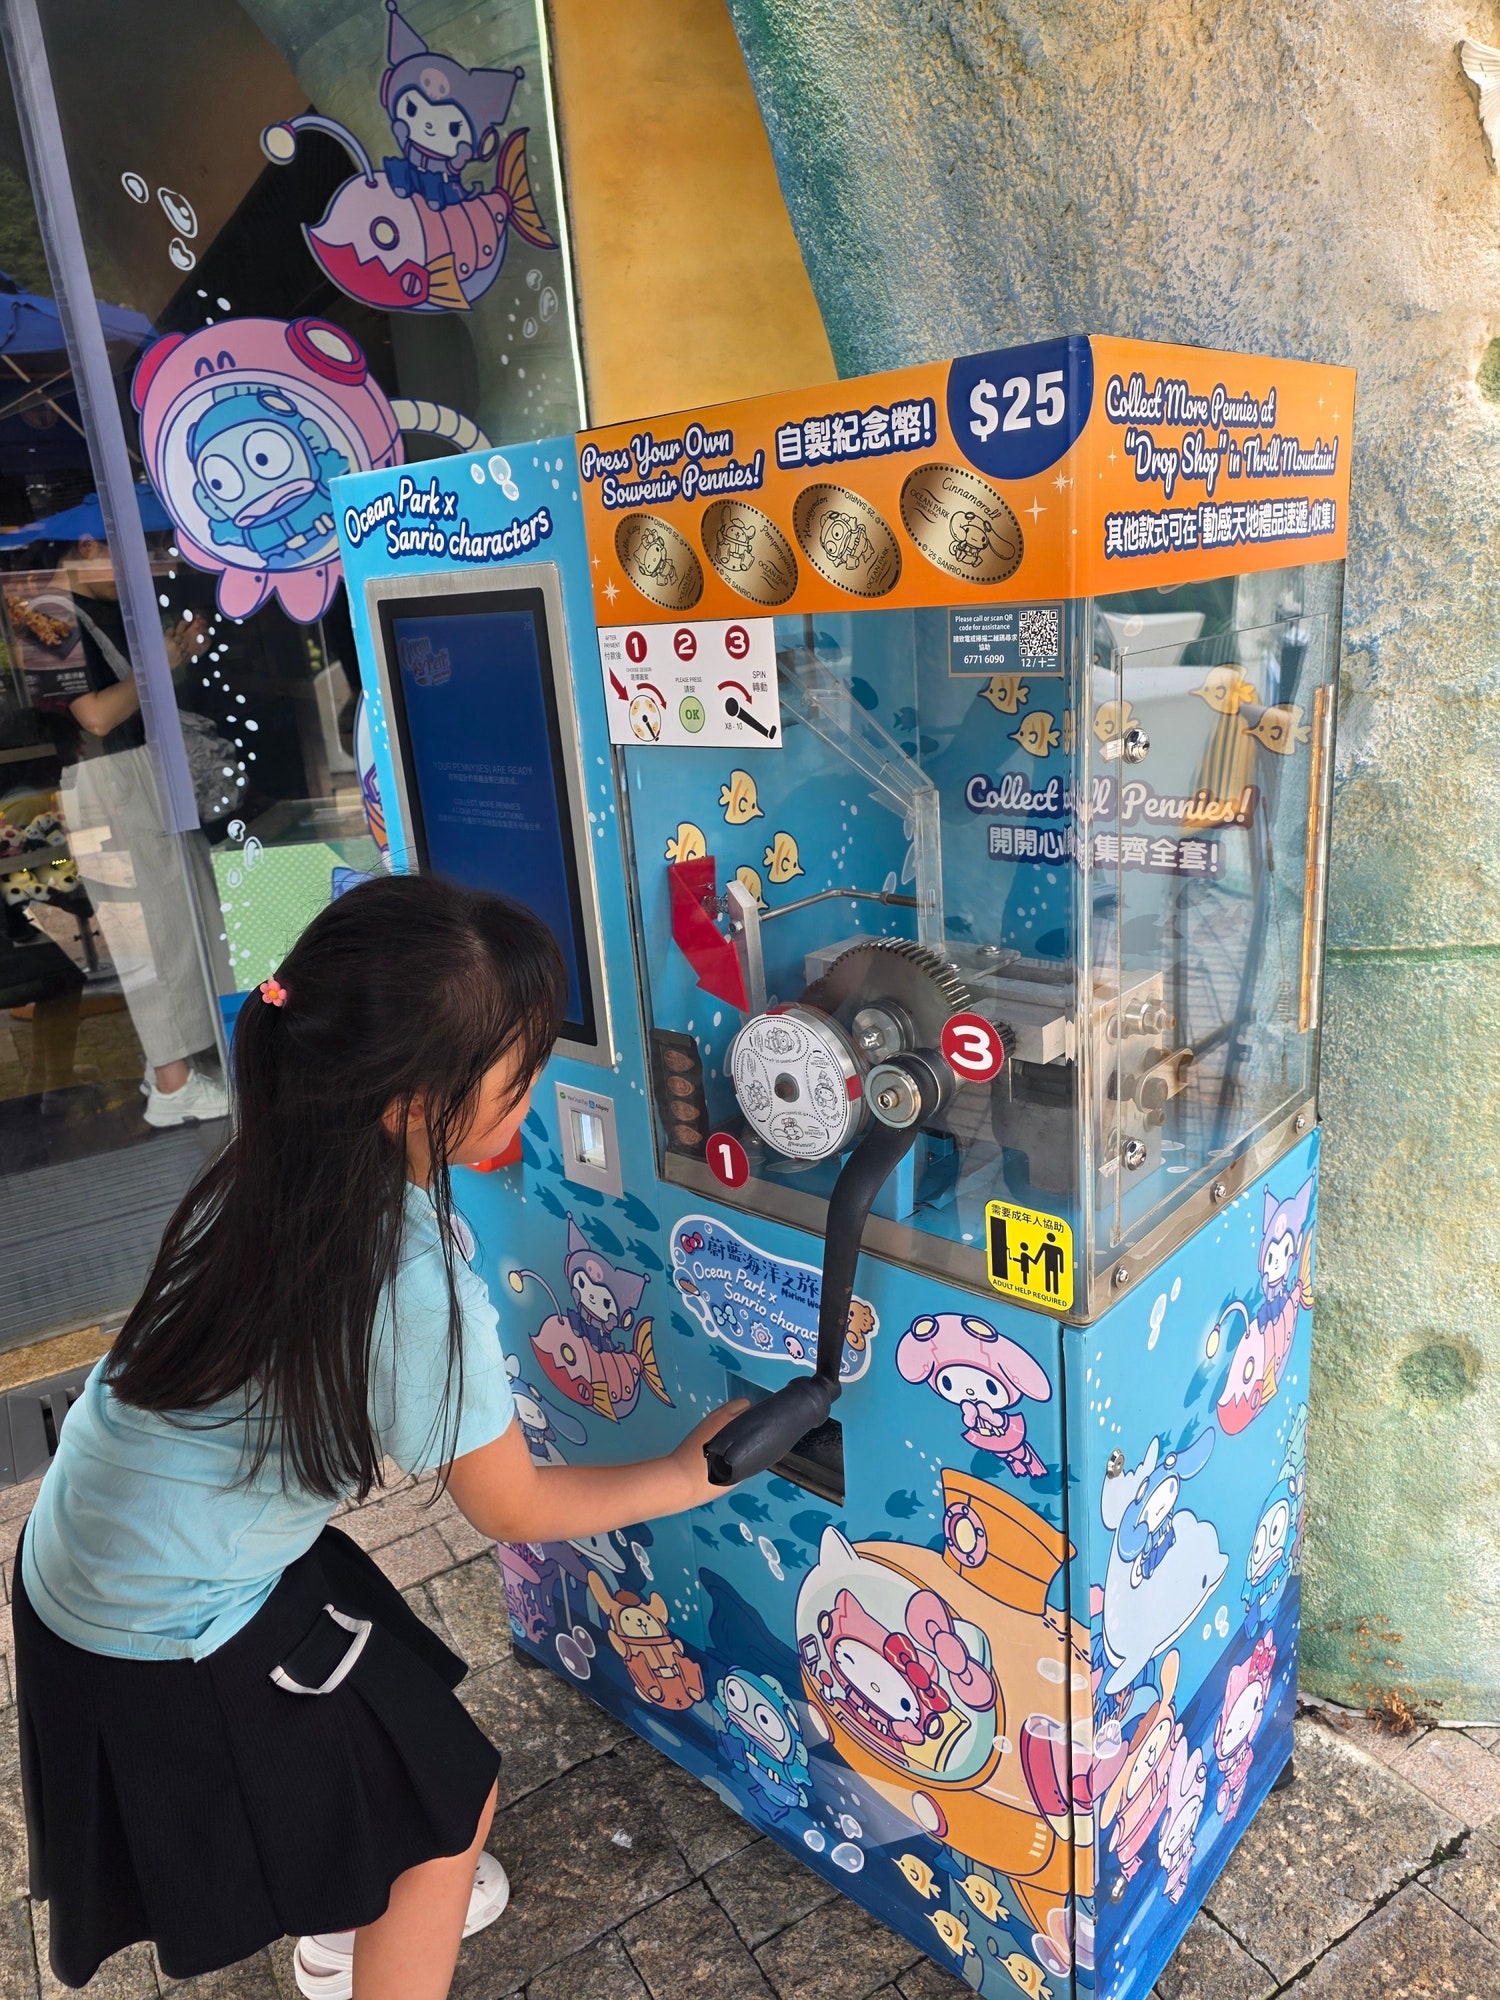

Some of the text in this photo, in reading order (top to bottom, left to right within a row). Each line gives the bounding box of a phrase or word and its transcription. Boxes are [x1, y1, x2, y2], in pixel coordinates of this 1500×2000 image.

[969, 371, 1065, 442] $25
[1107, 378, 1274, 423] Collect More Pennies at
[778, 404, 931, 462] 自製紀念幣!
[582, 428, 729, 478] Press Your Own
[1229, 441, 1240, 472] in
[1244, 439, 1278, 471] Thrill
[1282, 436, 1337, 470] Mountain!
[603, 456, 762, 505] Souvenir Pennies!
[345, 479, 455, 543] Ocean Park x
[844, 491, 867, 510] SANRIO
[910, 489, 950, 520] OCEAN PARK
[942, 477, 1002, 520] Cinnamoroll
[386, 510, 549, 556] Sanrio characters
[936, 556, 962, 576] SANRIO
[731, 581, 752, 598] SANRIO
[955, 615, 972, 623] Please
[981, 623, 1010, 631] assistance
[632, 637, 640, 658] 1
[678, 634, 693, 654] 2
[729, 632, 746, 654] 3
[964, 654, 1005, 664] 6771 6090
[1021, 657, 1056, 668] 12 / 十二
[752, 671, 767, 679] SPIN
[685, 709, 700, 720] OK
[737, 722, 743, 730] 10
[492, 765, 507, 774] ARE
[508, 766, 532, 776] READY
[966, 776, 1058, 812] Collect
[1122, 782, 1252, 823] Pennies!
[989, 826, 1218, 873] 開開心集齊全套!
[950, 1025, 994, 1070] 3
[718, 1144, 734, 1180] 1
[991, 1204, 1064, 1233] 需要成年人協助
[693, 1261, 778, 1304] Ocean Park x
[781, 1287, 806, 1305] Marine
[992, 1279, 1068, 1307] ADULT HELP REQUIRED
[724, 1282, 818, 1341] Sanrio charac
